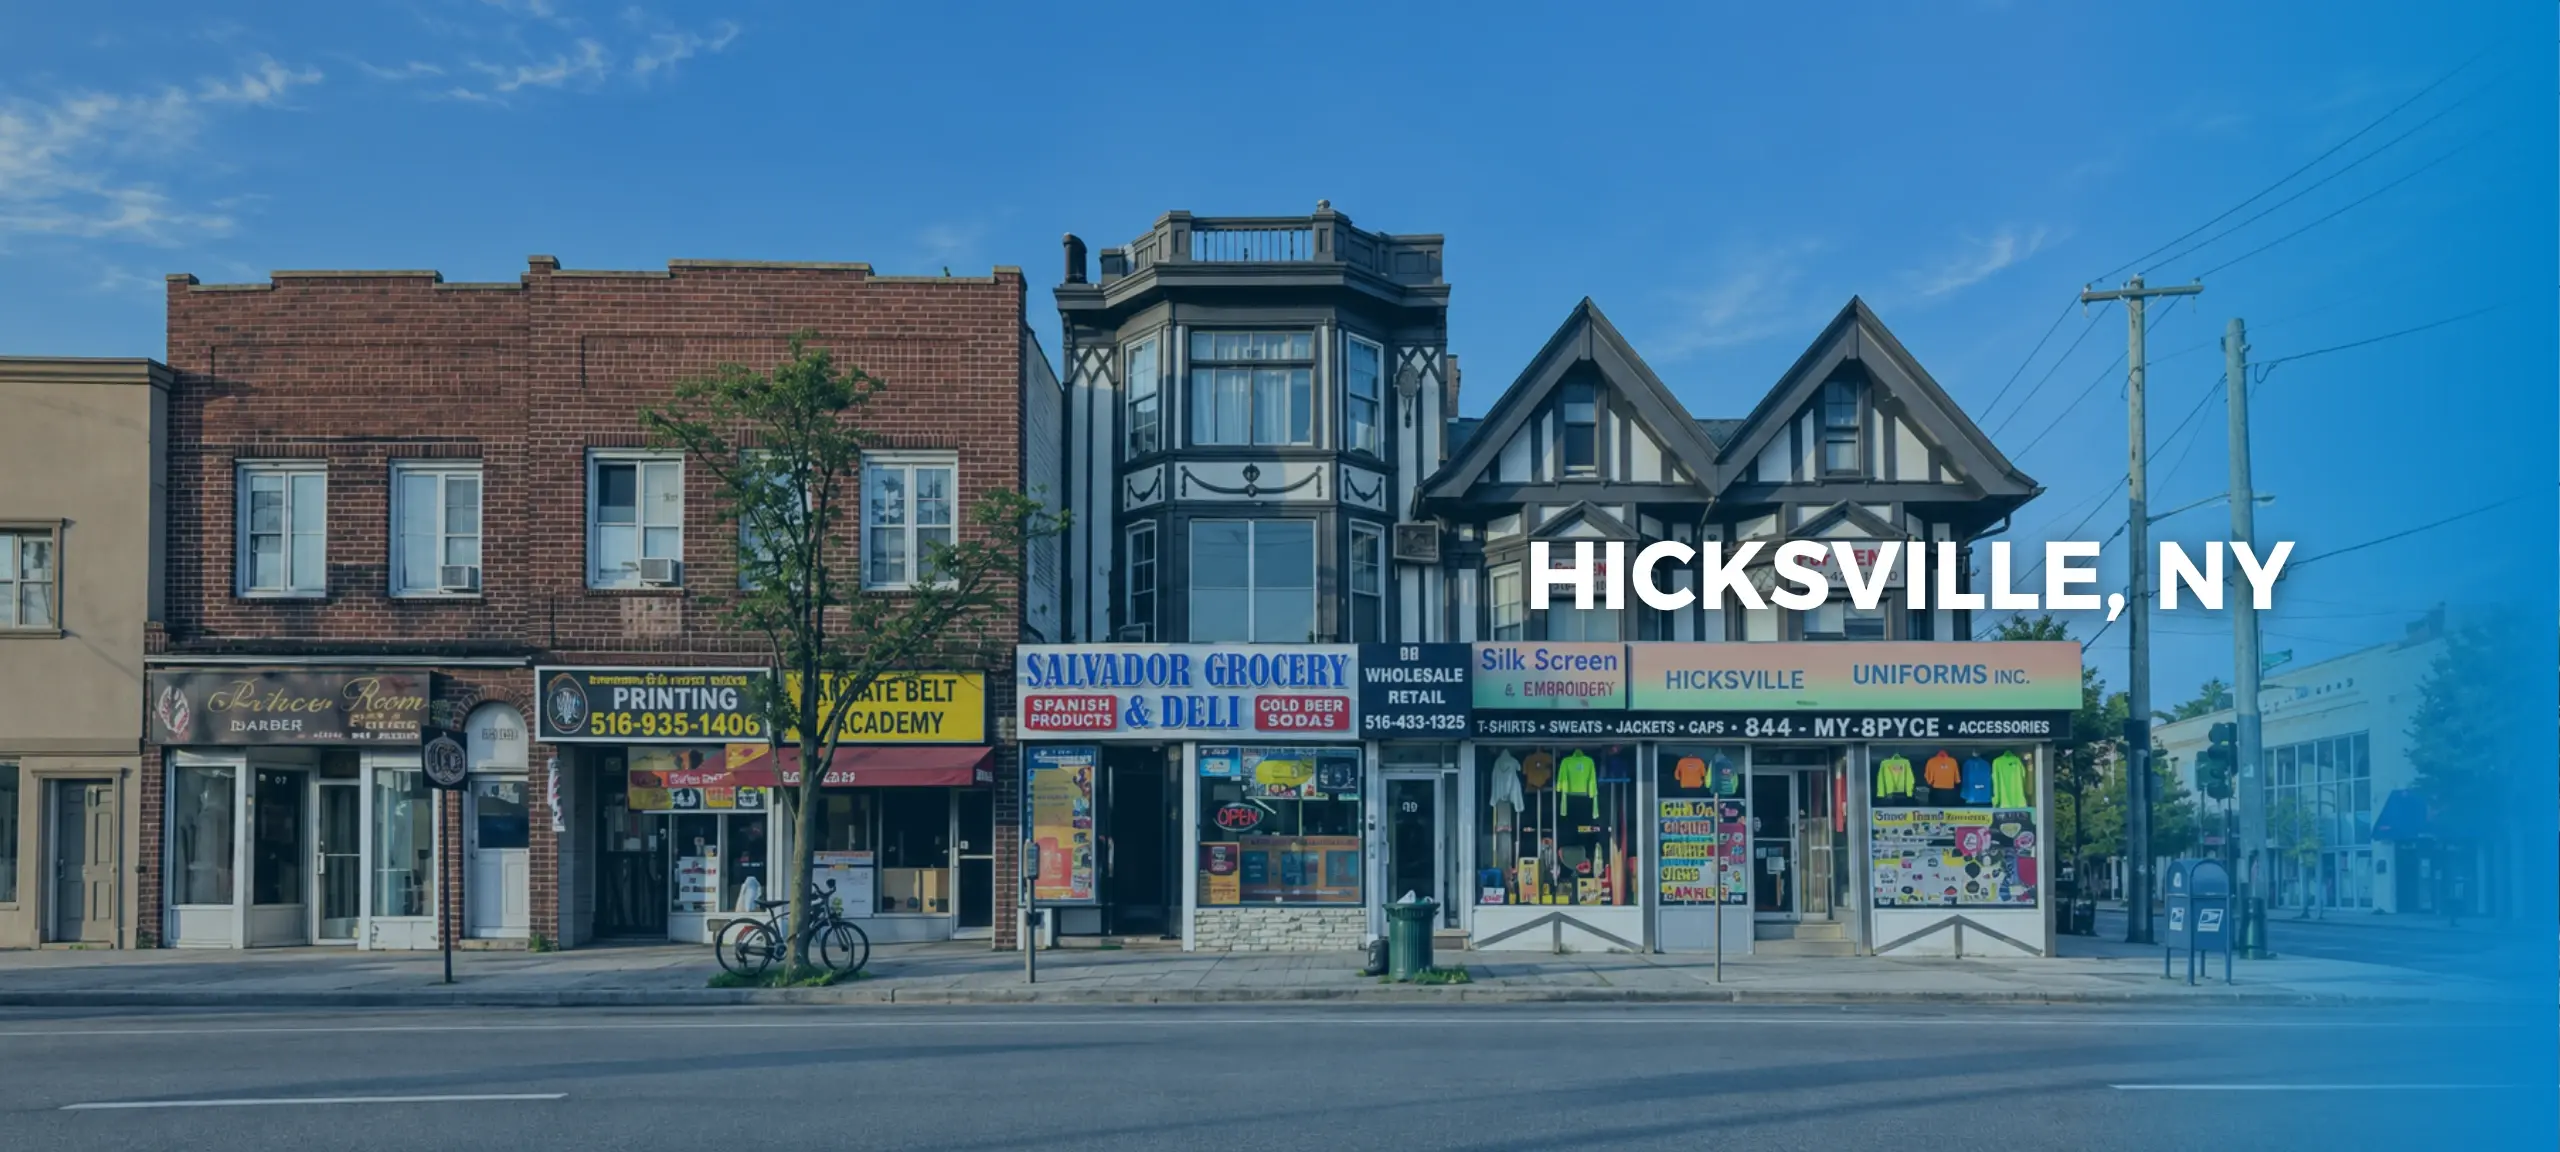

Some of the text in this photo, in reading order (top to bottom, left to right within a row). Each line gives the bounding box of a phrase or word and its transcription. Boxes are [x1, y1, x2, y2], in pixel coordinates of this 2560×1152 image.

[1481, 648, 1617, 671] Silk Screen
[1026, 652, 1349, 688] SALVADOR GROCERY
[1365, 667, 1464, 683] WHOLESALE
[1666, 664, 2031, 689] HICKSVILLE UNIFORMS INC.
[613, 687, 739, 710] PRINTING
[906, 679, 957, 702] BELT
[1388, 690, 1446, 704] RETAIL
[1523, 681, 1615, 697] EMBROIDERY
[1033, 698, 1110, 713] SPANISH
[1124, 694, 1242, 730] & DELI
[1259, 699, 1344, 713] COLD BEER
[590, 711, 761, 736] 516-935-1406
[1030, 714, 1113, 728] PRODUCTS
[1267, 714, 1336, 728] SODAS
[1365, 714, 1466, 729] 516-433-1325
[1477, 720, 1536, 734] T-SHIRTS
[1549, 720, 1603, 734] SWEATS
[1616, 720, 1676, 734] JACKETS
[1688, 720, 1725, 734] CAPS
[1744, 717, 1793, 738] 844
[1814, 717, 1940, 738] MY-8PYCE
[1958, 720, 2050, 734] ACCESSORIES
[1217, 807, 1258, 826] OPEN
